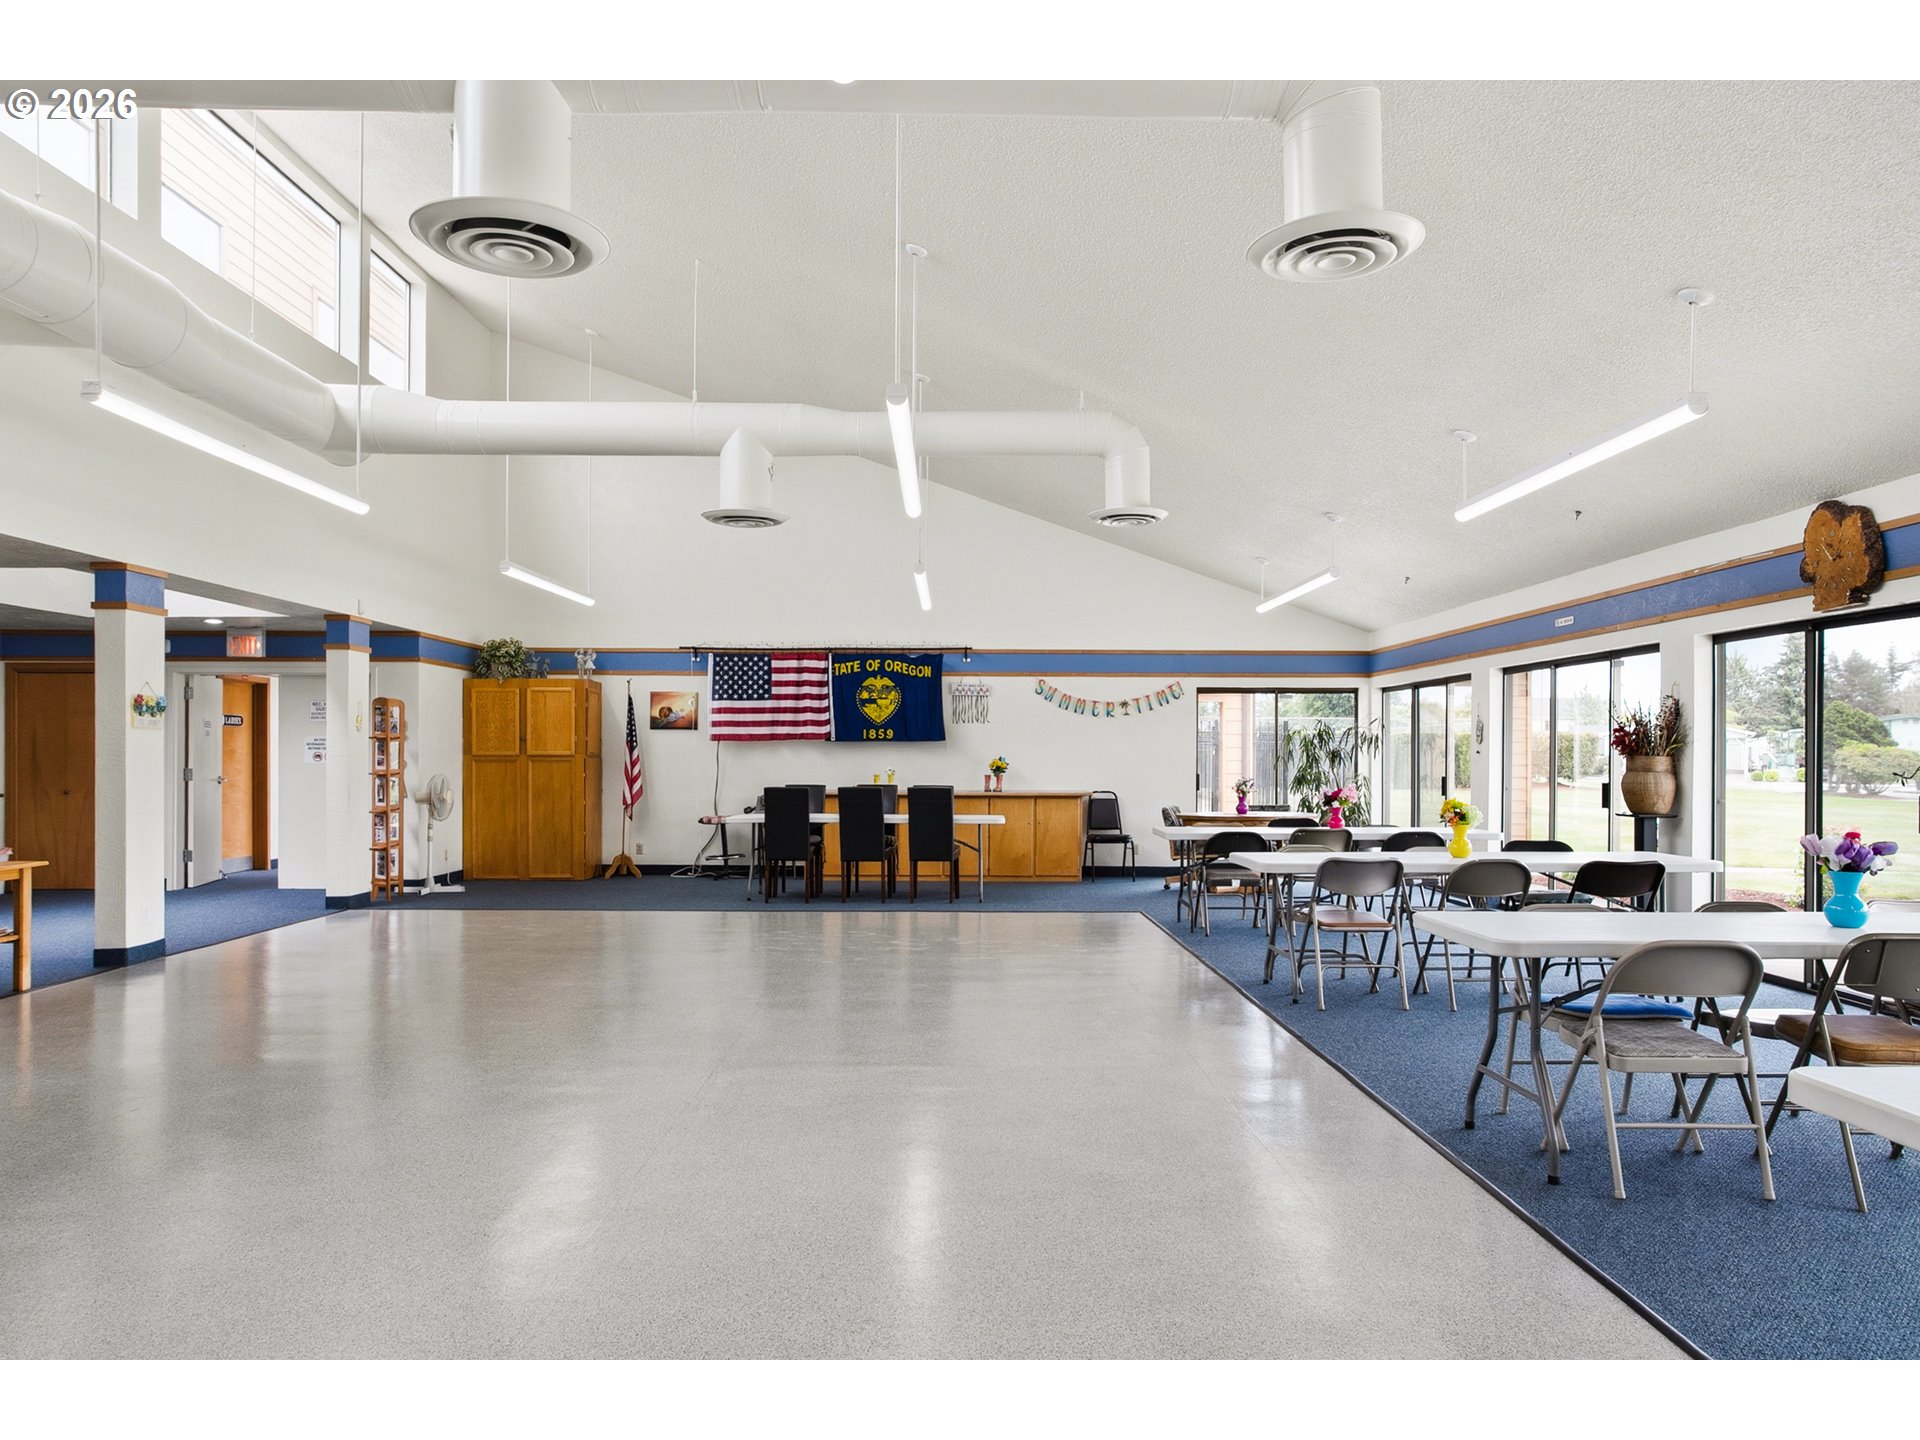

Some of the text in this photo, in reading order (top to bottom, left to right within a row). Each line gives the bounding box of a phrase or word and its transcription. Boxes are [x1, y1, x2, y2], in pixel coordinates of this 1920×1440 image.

[231, 636, 257, 656] EXIT
[832, 659, 932, 678] TATE OF OREGON
[225, 716, 242, 725] LADIES
[863, 728, 894, 740] 1859
